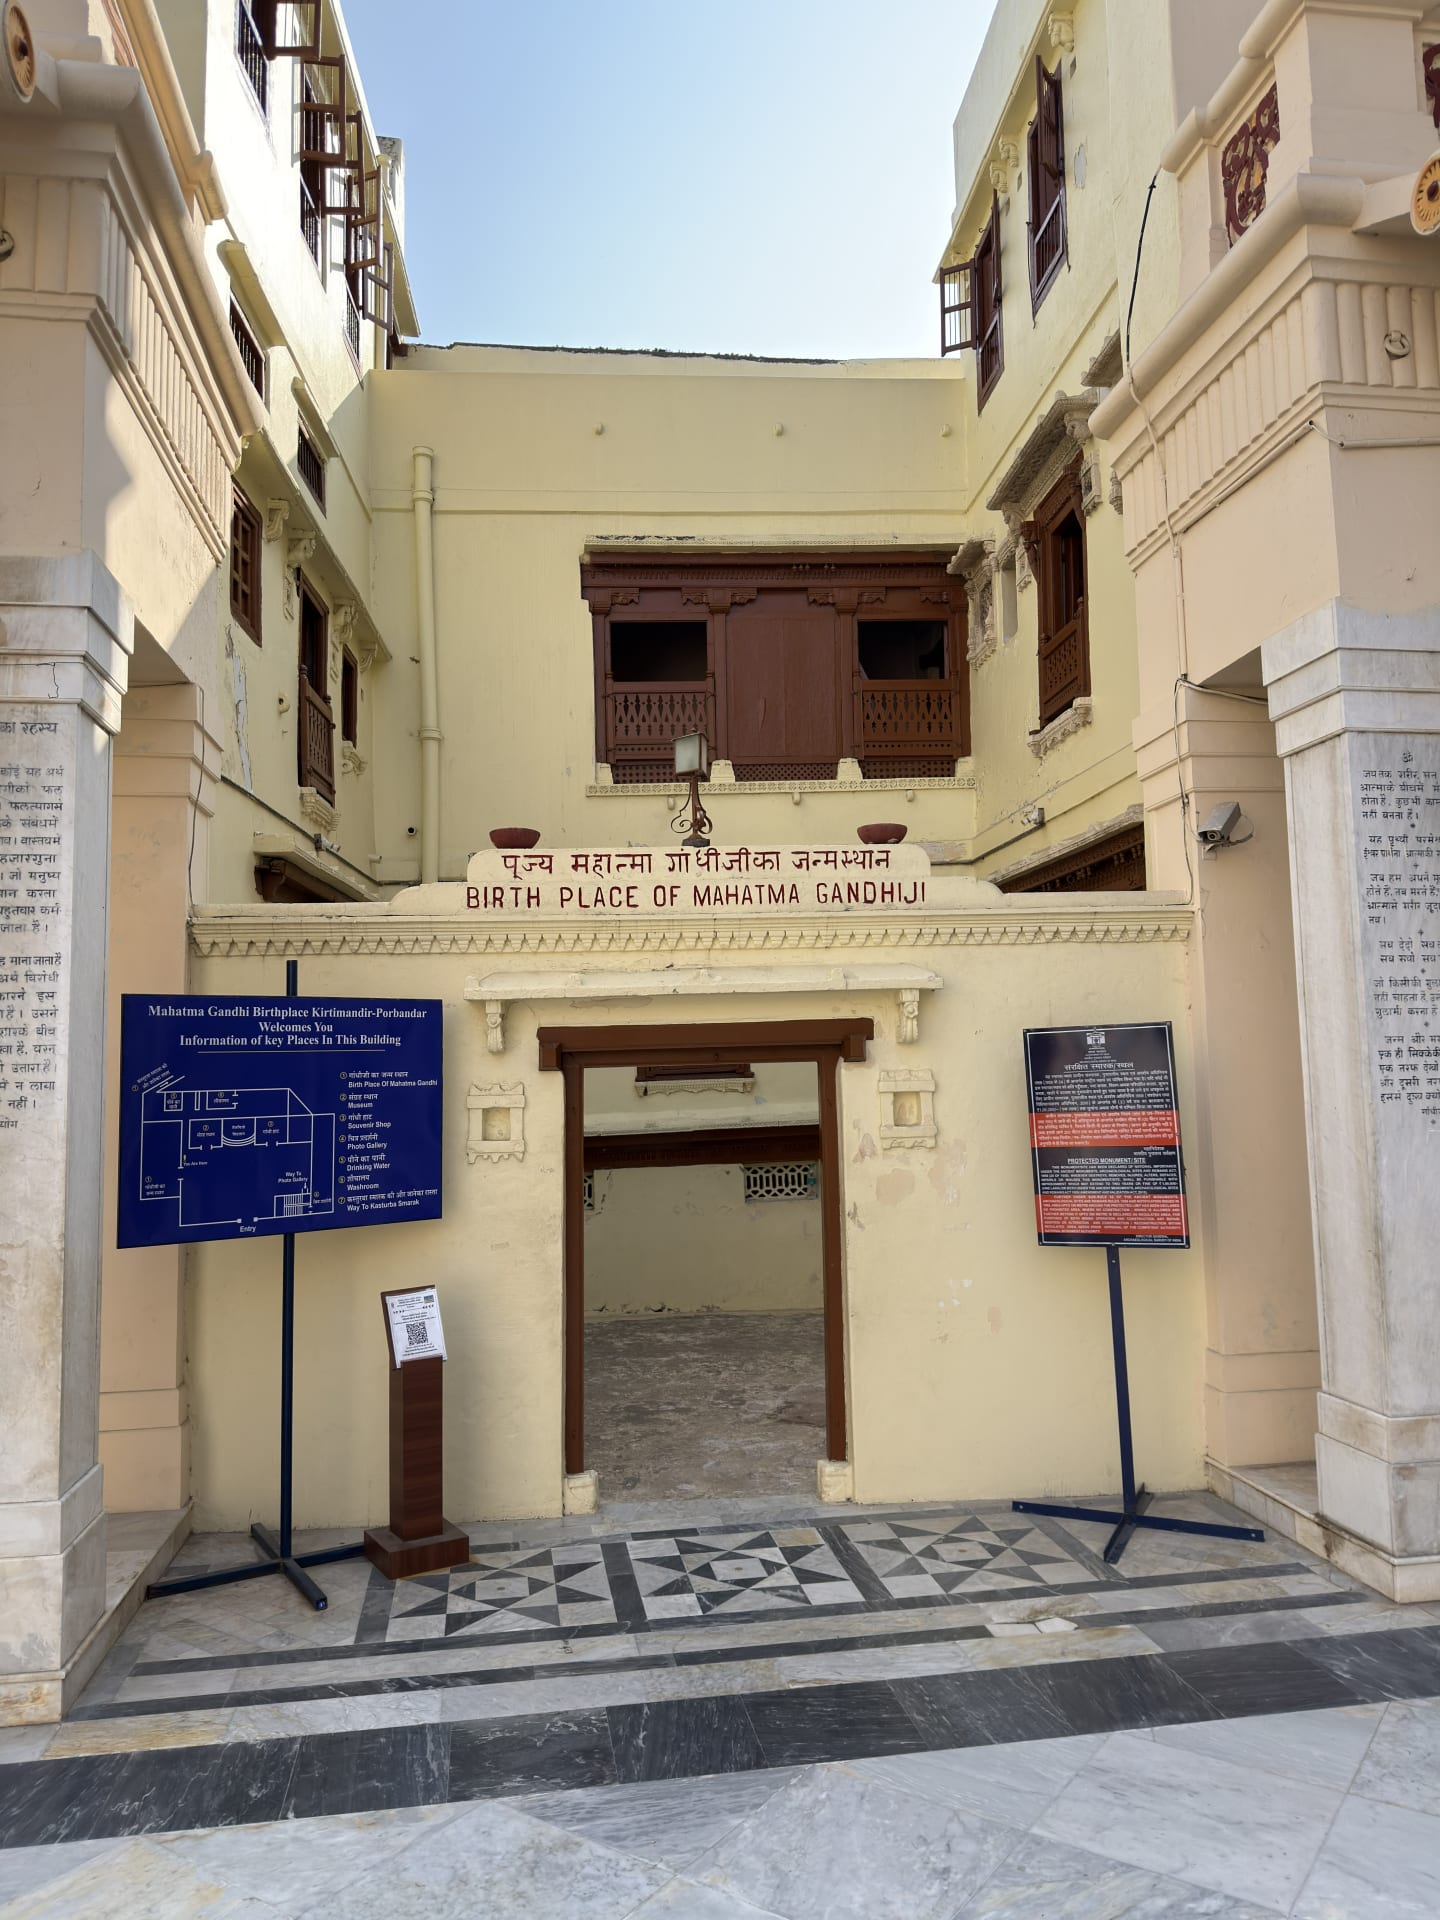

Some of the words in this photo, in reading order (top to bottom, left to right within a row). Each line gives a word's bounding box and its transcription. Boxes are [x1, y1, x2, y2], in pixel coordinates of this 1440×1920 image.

[502, 854, 554, 881] पूज्य
[466, 886, 541, 909] BIRTH
[559, 885, 640, 909] PLACE
[653, 885, 681, 908] OF
[693, 883, 800, 907] MAHATMA
[816, 881, 926, 904] GANDHIJI
[148, 1005, 205, 1017] Mahatma
[208, 1006, 250, 1017] Gandhi
[252, 1006, 309, 1020] Birthplace
[312, 1007, 427, 1018] Kirtimandir-Porbandar
[258, 1021, 312, 1032] Welcomes
[314, 1021, 333, 1032] You
[179, 1034, 248, 1046] Information
[250, 1034, 263, 1046] of
[265, 1035, 284, 1048] key
[287, 1034, 319, 1045] Places
[322, 1034, 333, 1045] In
[336, 1034, 357, 1045] This
[360, 1034, 402, 1047] Building
[417, 1079, 438, 1087] Gandhi
[375, 1121, 391, 1129] Shop
[366, 1141, 388, 1149] Gallery
[347, 1164, 372, 1172] Drinking
[373, 1162, 390, 1170] Water
[347, 1183, 380, 1191] Washroom
[347, 1204, 360, 1212] Way
[362, 1203, 369, 1211] To
[370, 1201, 397, 1209] Kasturba
[398, 1199, 419, 1207] Smarak
[240, 1225, 256, 1233] Entry
